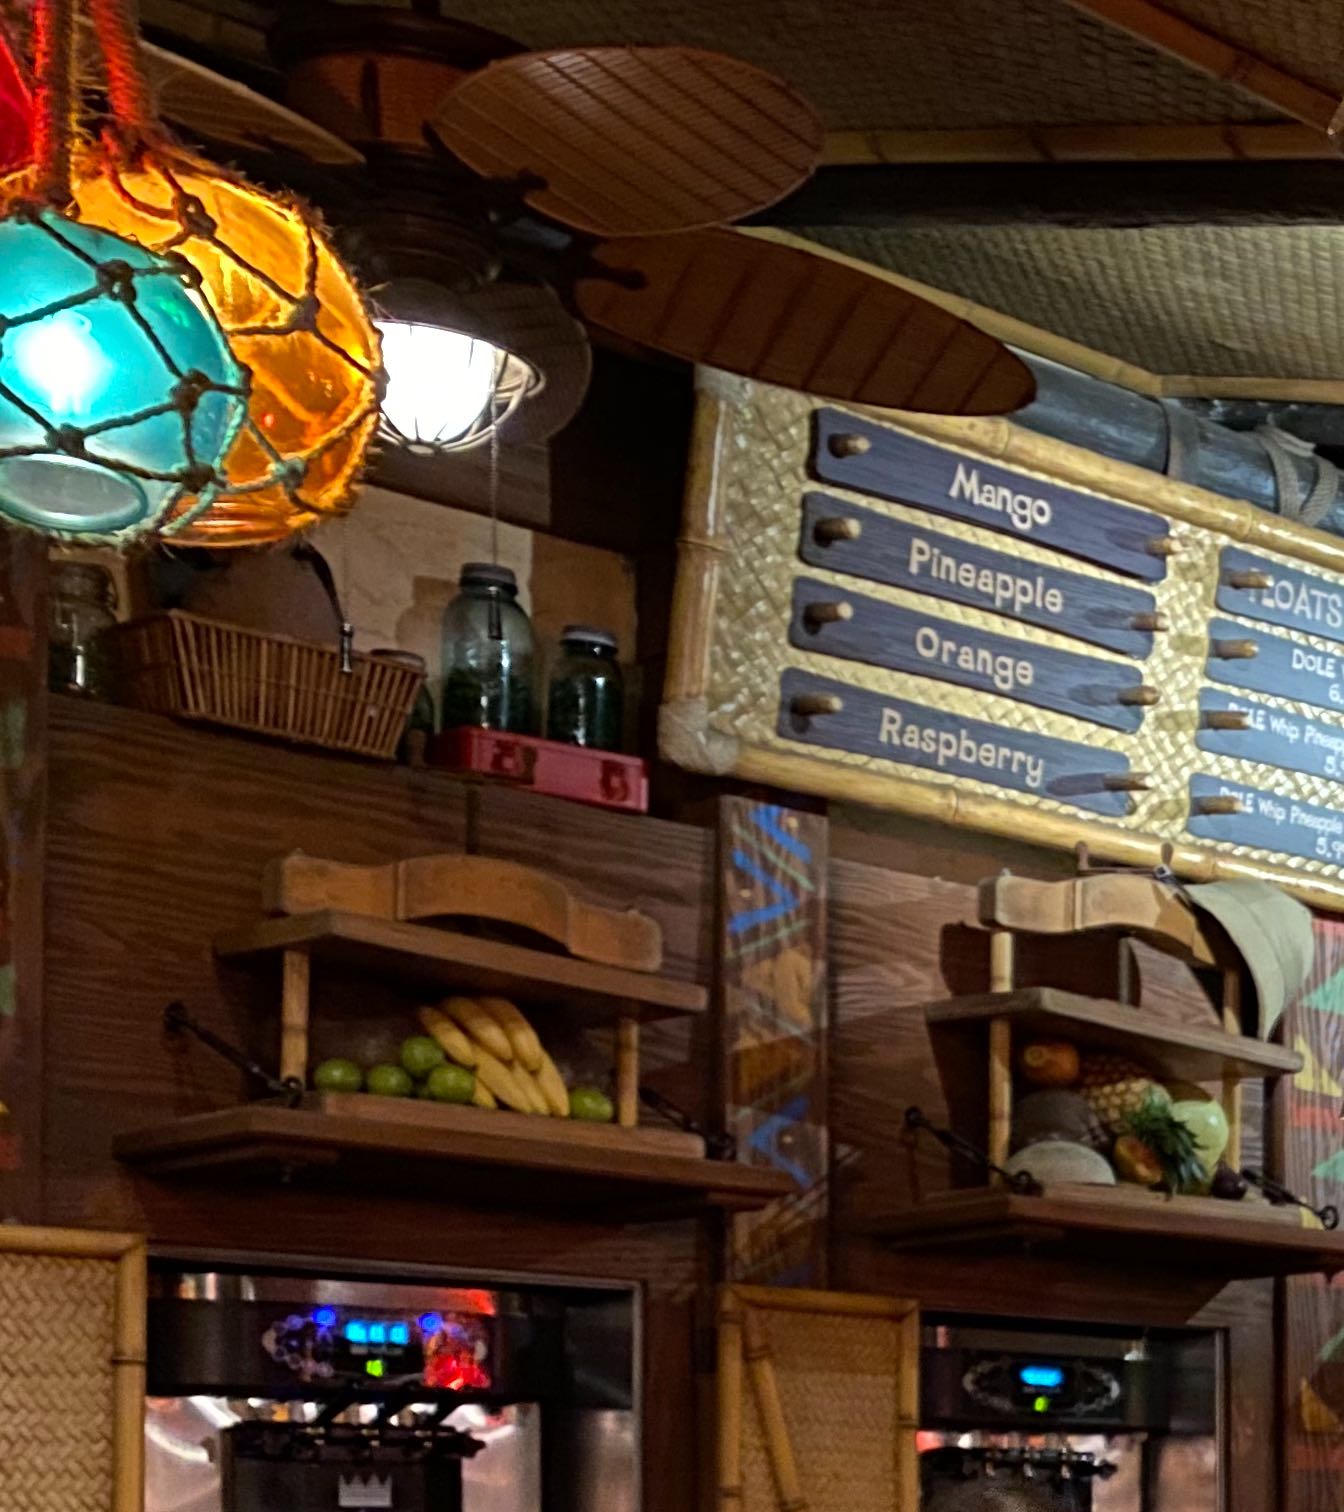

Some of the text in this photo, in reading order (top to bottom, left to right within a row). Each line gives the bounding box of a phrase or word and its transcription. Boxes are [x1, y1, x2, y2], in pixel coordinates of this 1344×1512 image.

[949, 462, 1052, 530] Mango
[908, 538, 1064, 613] Pineapple
[915, 626, 1035, 690] Orange
[1291, 649, 1337, 679] DOLE
[879, 707, 1045, 787] Raspberry
[1270, 716, 1300, 744] Whip
[1258, 796, 1286, 825] Whip
[1290, 806, 1343, 839] Pineapple
